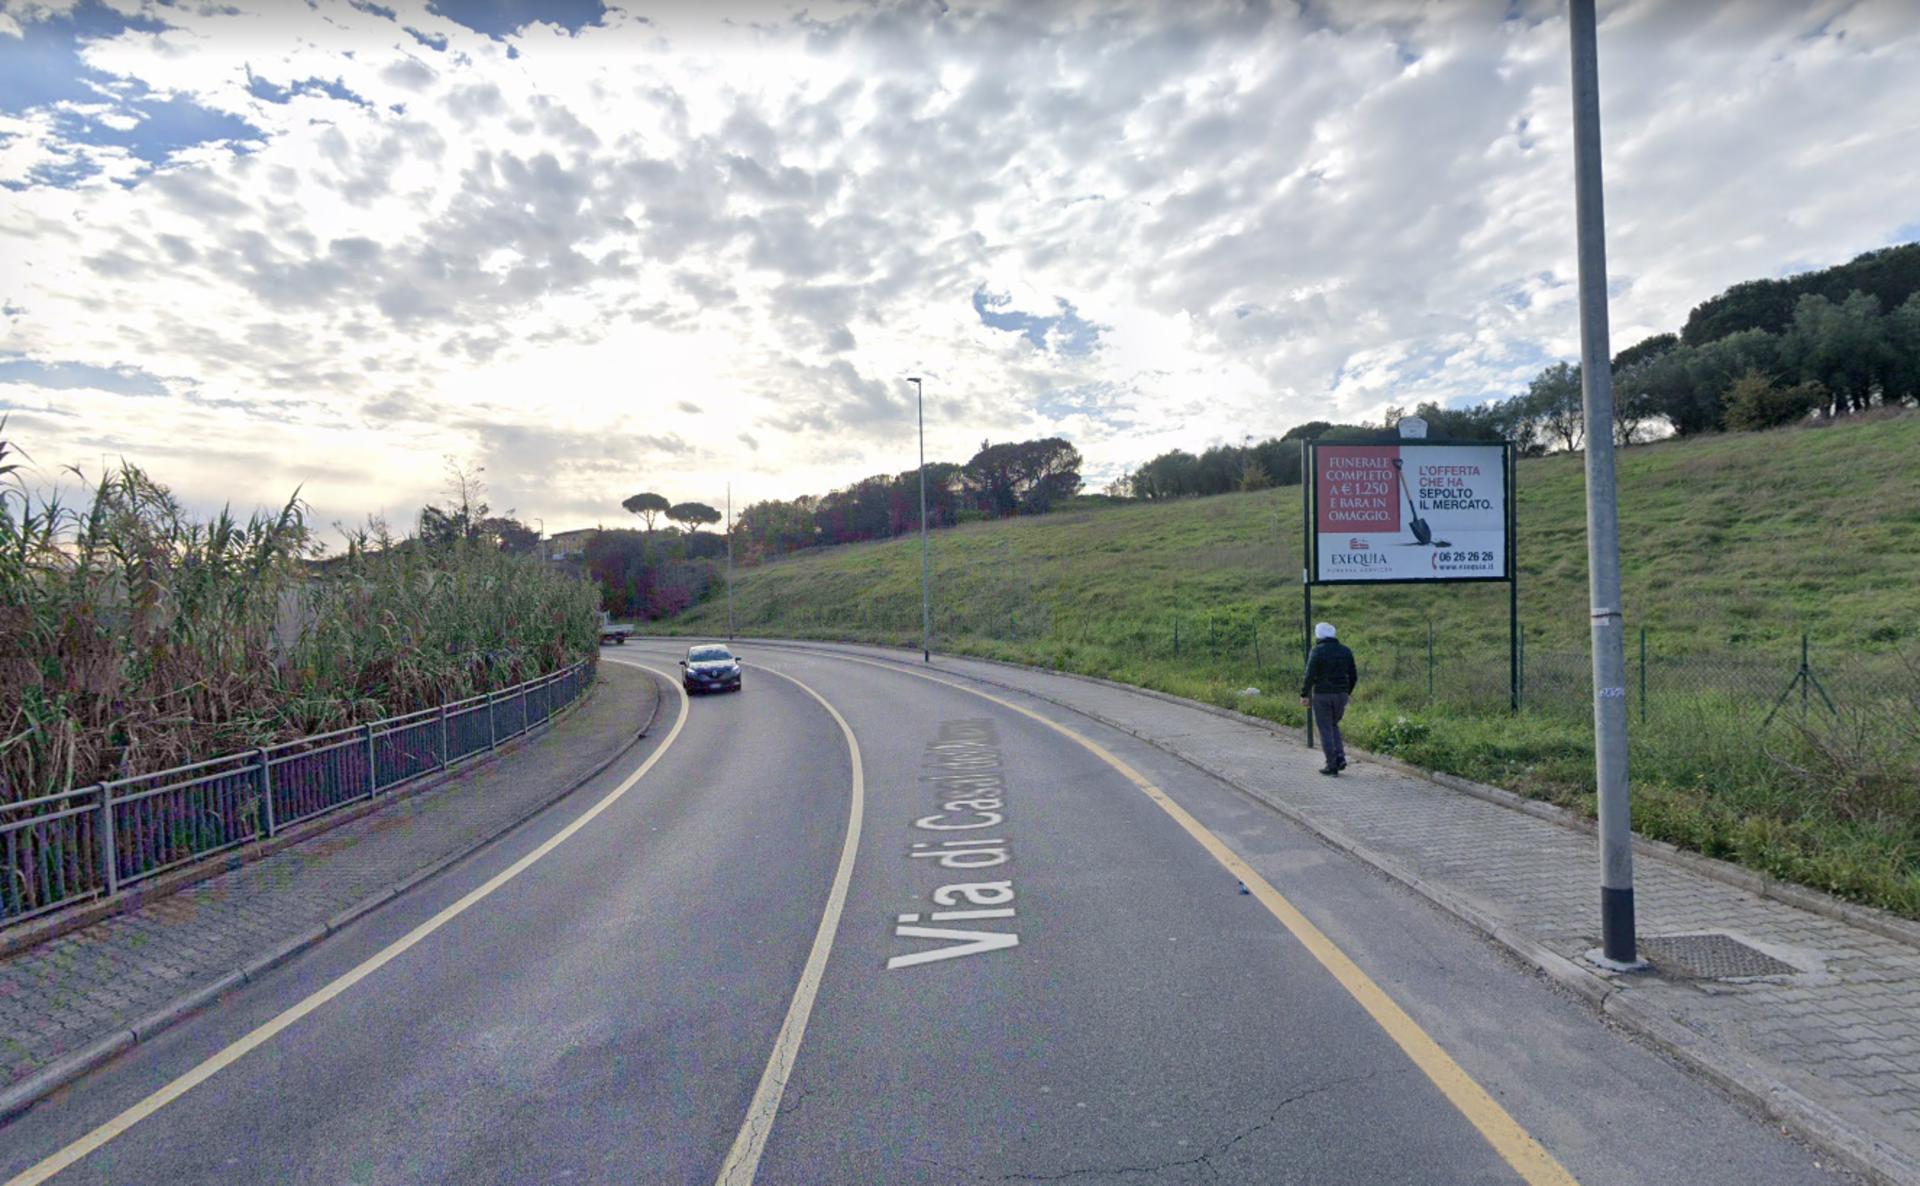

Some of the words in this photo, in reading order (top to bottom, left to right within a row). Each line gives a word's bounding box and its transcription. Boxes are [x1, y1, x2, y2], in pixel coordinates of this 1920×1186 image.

[1329, 457, 1390, 468] FUNERALE
[1326, 470, 1393, 481] COMPLETO
[1419, 465, 1480, 476] L'OFFERTA
[1419, 477, 1444, 487] CHE
[1447, 477, 1464, 487] HA
[1419, 488, 1473, 499] SEPOLTO
[1330, 498, 1338, 508] E
[1340, 498, 1370, 508] BARA
[1372, 498, 1387, 508] IN
[1419, 499, 1430, 510] IL
[1433, 499, 1493, 510] MERCATO.
[1331, 553, 1387, 566] EXEQUIA
[1439, 552, 1452, 562] 06
[1453, 551, 1466, 562] 26
[1467, 551, 1480, 562] 26
[1481, 551, 1494, 562] 26
